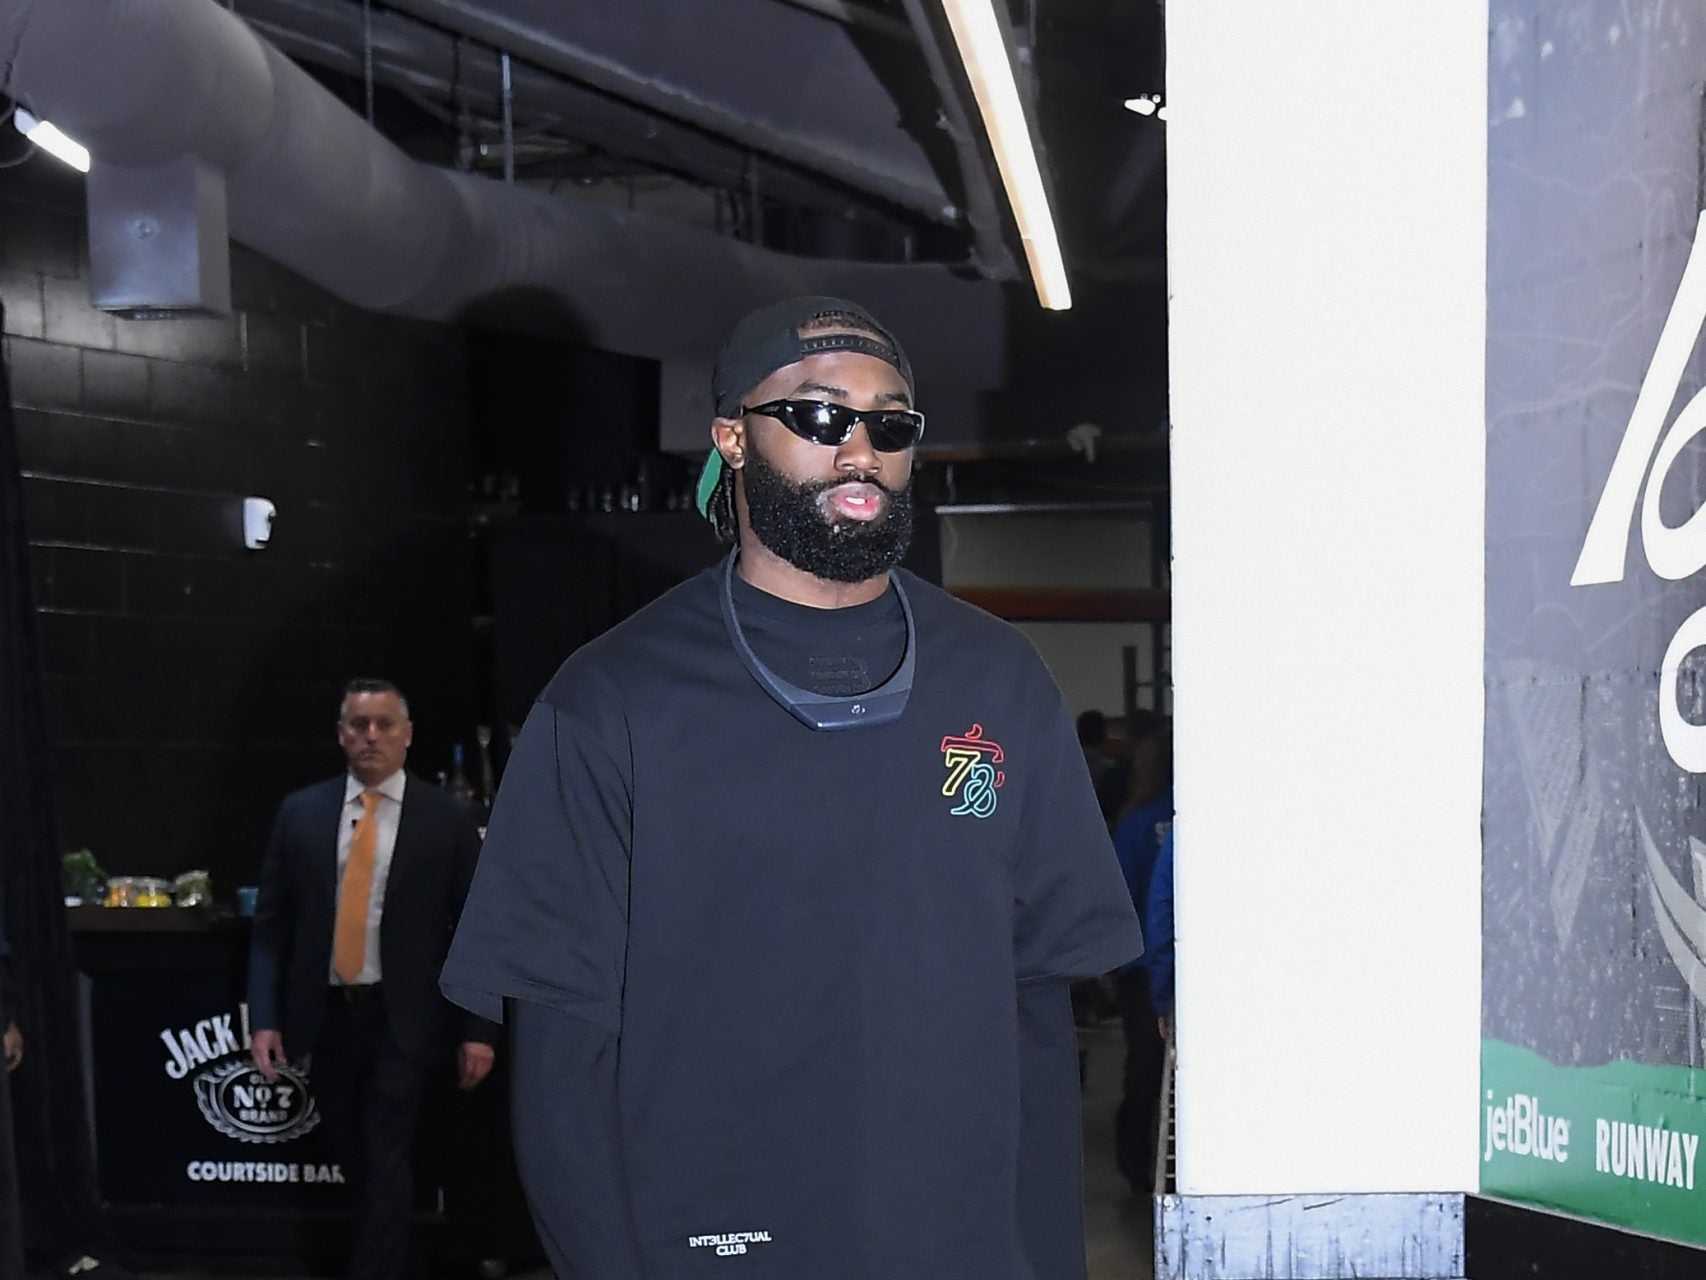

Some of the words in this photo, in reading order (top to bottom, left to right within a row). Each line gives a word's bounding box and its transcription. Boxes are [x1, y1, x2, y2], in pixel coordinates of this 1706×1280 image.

[160, 1013, 241, 1079] JACK
[1484, 1089, 1570, 1162] jetBlue
[1596, 1118, 1699, 1190] RUNWAY
[187, 1160, 300, 1182] COURTSIDE
[716, 1244, 747, 1256] CLUB
